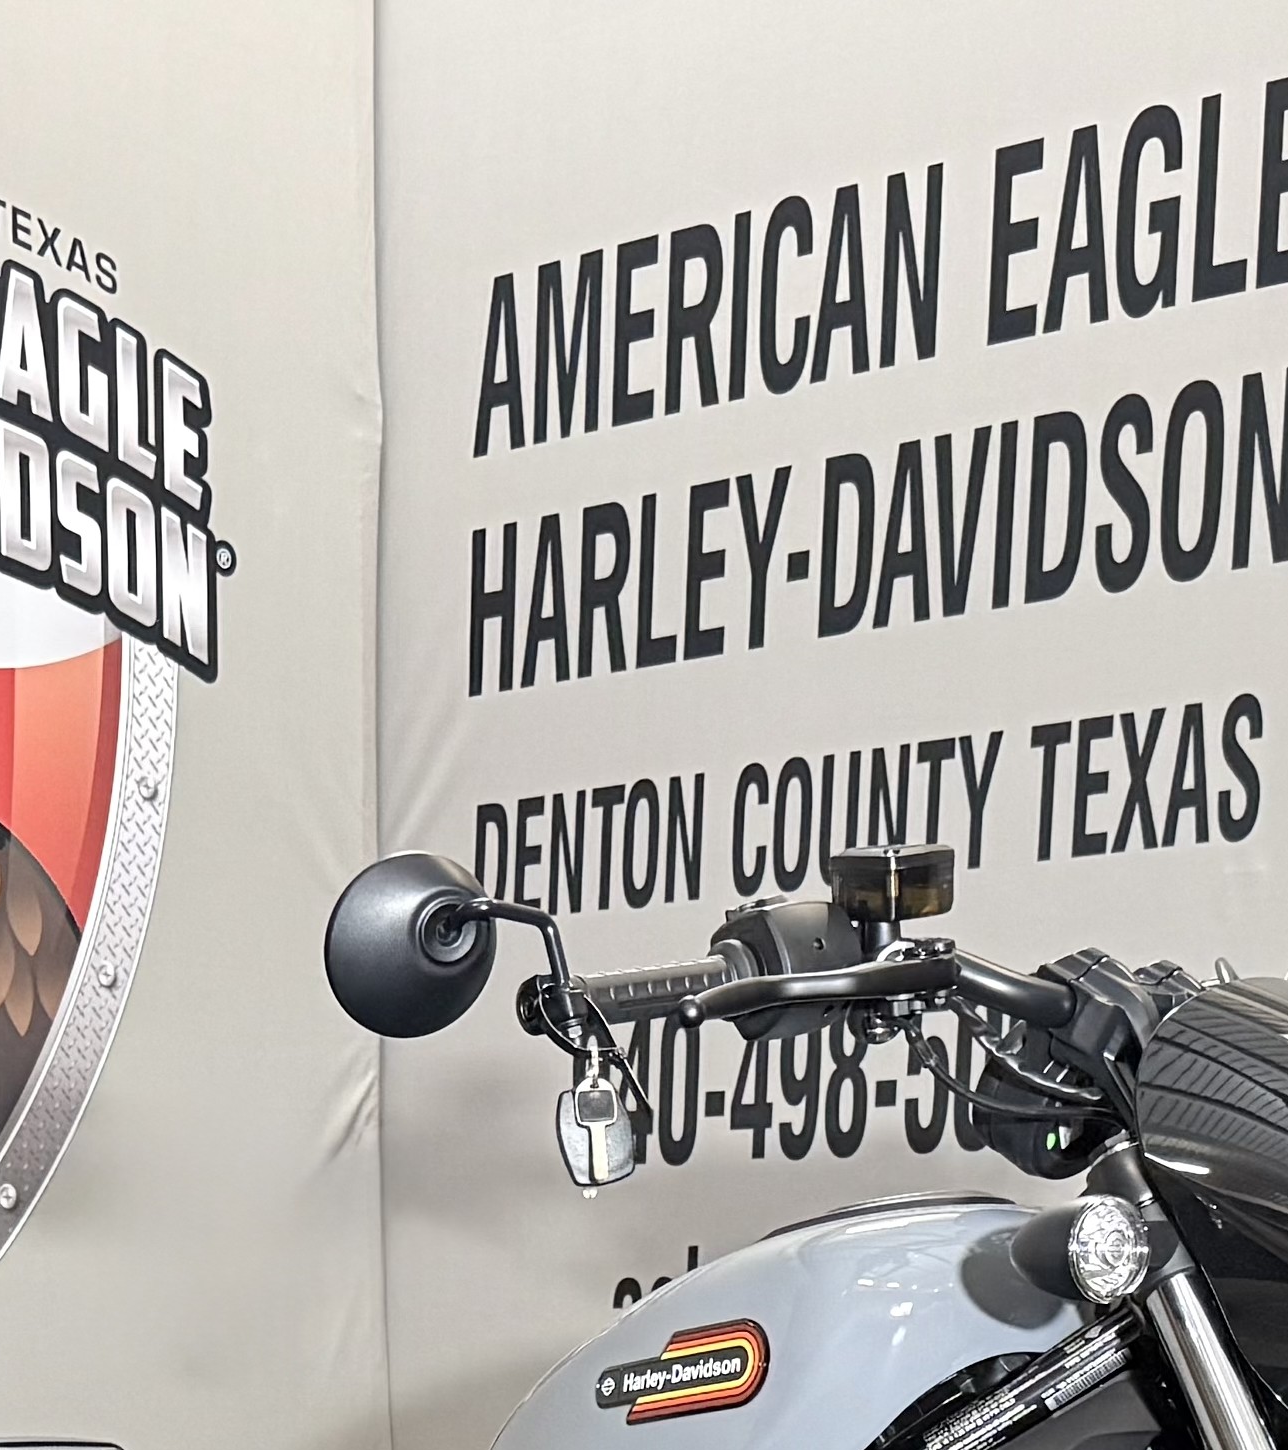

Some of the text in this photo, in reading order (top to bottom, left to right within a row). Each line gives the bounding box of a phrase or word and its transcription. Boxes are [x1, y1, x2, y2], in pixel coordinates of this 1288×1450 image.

[472, 162, 944, 458] AMERICAN
[474, 693, 1264, 916] DENTON COUNTY TEXAS
[622, 1356, 742, 1393] Harley-Davidson
